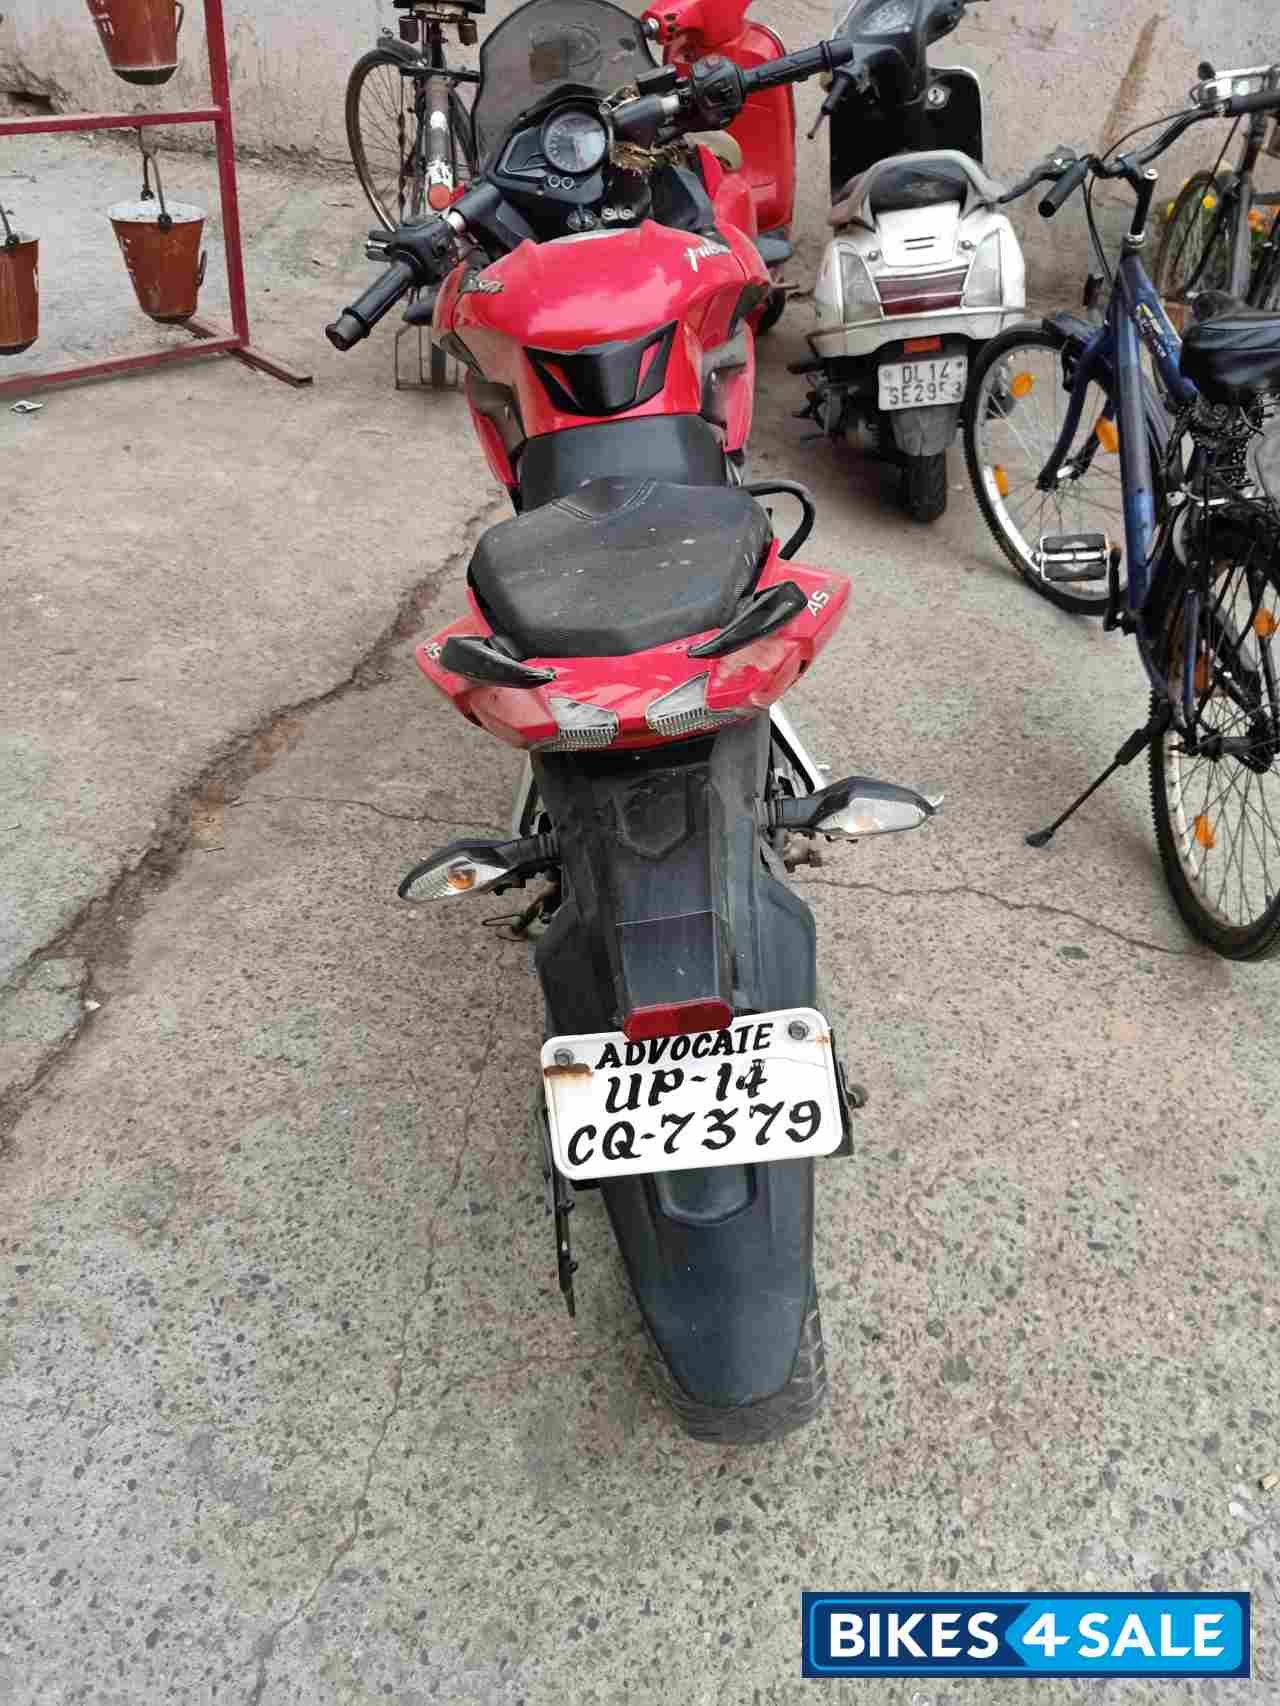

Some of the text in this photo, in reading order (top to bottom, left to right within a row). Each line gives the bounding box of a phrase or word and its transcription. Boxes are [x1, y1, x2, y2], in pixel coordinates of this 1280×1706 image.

[808, 591, 830, 617] AS
[595, 1022, 773, 1070] ADVOCATE
[605, 1058, 767, 1114] UP-14
[567, 1099, 822, 1166] CQ-7379
